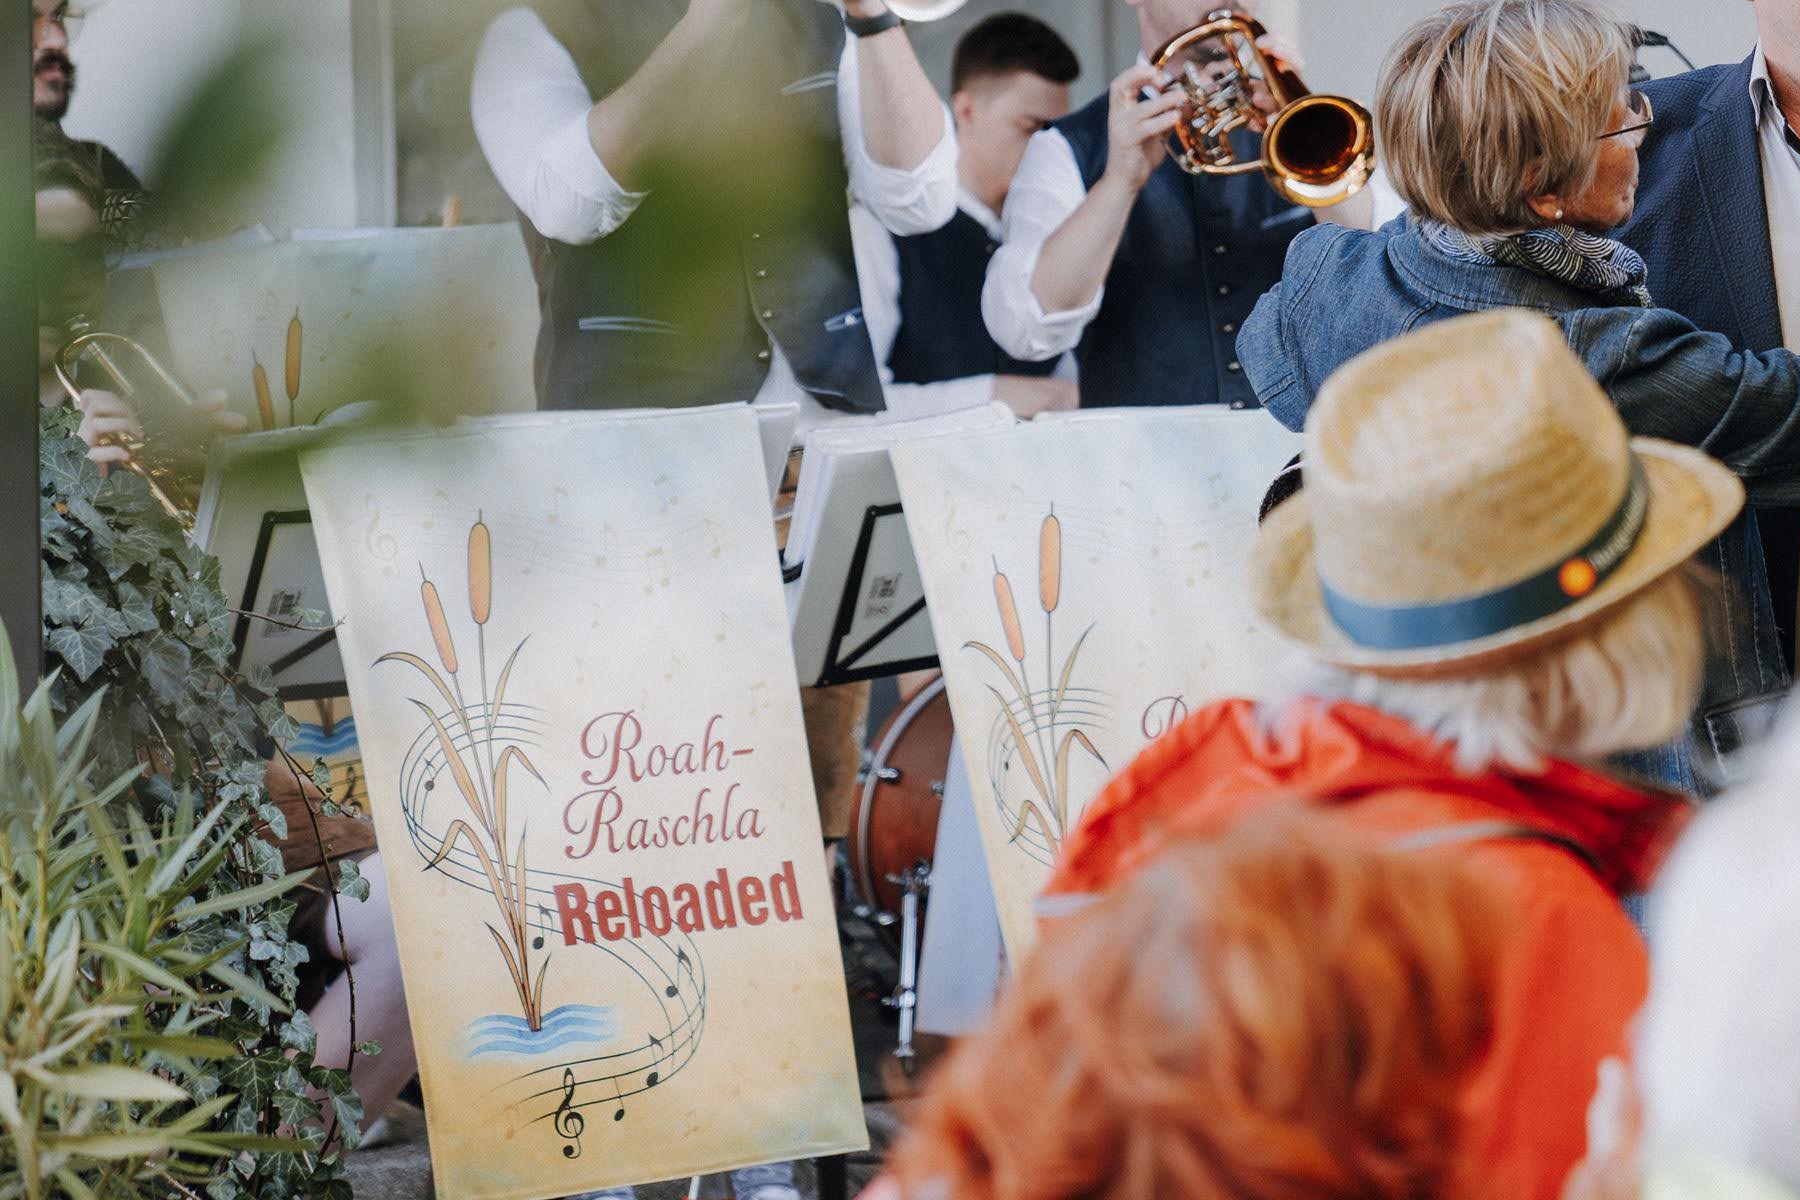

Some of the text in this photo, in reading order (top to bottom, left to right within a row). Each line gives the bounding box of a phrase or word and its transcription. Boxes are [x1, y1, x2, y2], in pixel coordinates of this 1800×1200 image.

[581, 709, 754, 785] Roah-
[563, 783, 765, 859] Raschla
[553, 860, 803, 946] Reloaded
